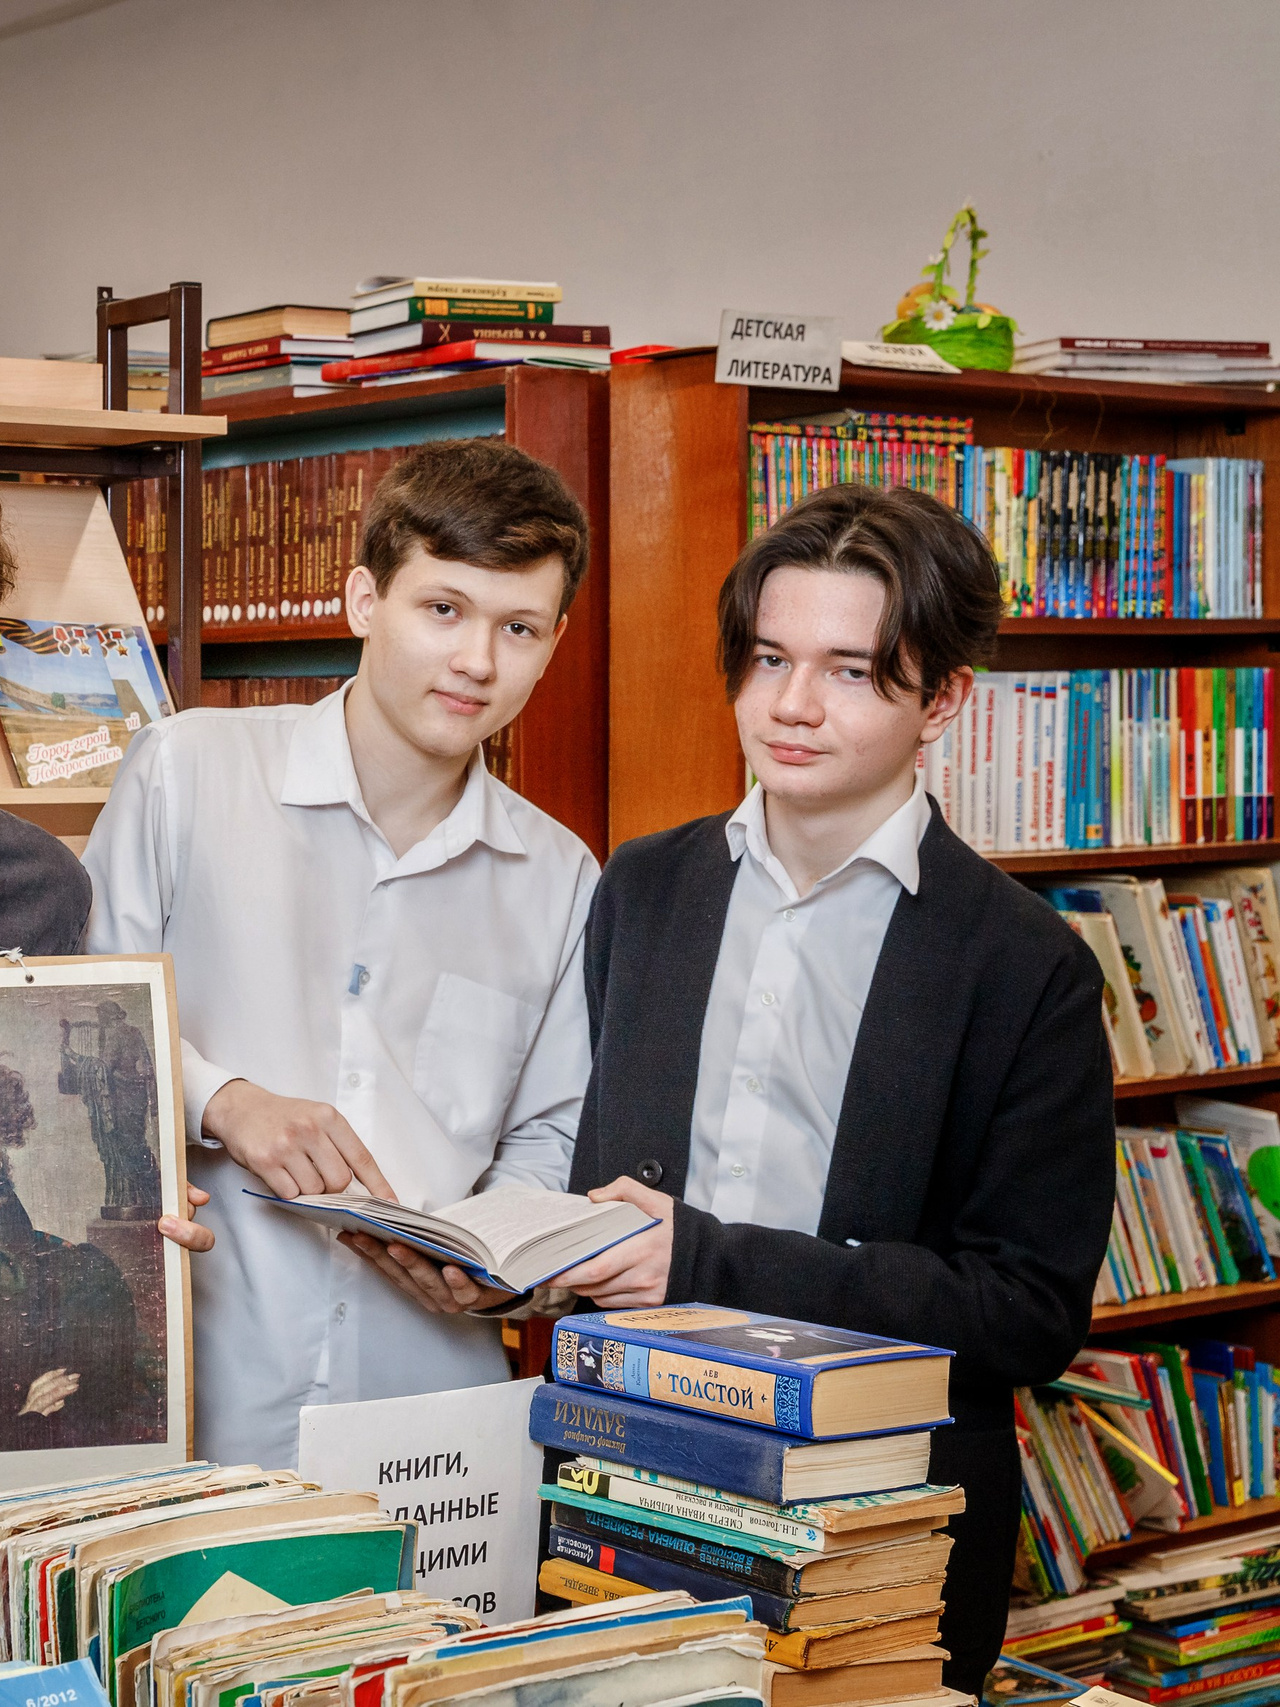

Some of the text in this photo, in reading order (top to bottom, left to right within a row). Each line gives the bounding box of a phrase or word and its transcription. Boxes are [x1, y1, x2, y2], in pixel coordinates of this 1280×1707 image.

[731, 318, 806, 342] ДЕТСКАЯ
[727, 359, 833, 385] ЛИТЕРАТУРА
[31, 747, 122, 782] Новороссийск
[703, 1369, 719, 1379] ЛЕВ
[667, 1372, 755, 1411] ТОЛСТОЙ
[552, 1398, 627, 1439] ЗАУЛКИ
[563, 1429, 627, 1454] Виктор Смирнов
[379, 1451, 469, 1485] КНИГИ,
[388, 1492, 499, 1527] ДАННЫЕ
[675, 1492, 707, 1507] рассказы
[714, 1501, 744, 1518] Повести
[638, 1496, 743, 1529] СМЕРТЬ ИВАНА ИЛЬИЧА
[584, 1510, 695, 1554] ОШИБКА РЕЗИДЕНТА
[749, 1516, 799, 1537] Л.Н.Толстой
[452, 1591, 497, 1614] ОВ
[603, 1590, 625, 1601] ЕБА
[25, 1688, 78, 1707] 6/2012
